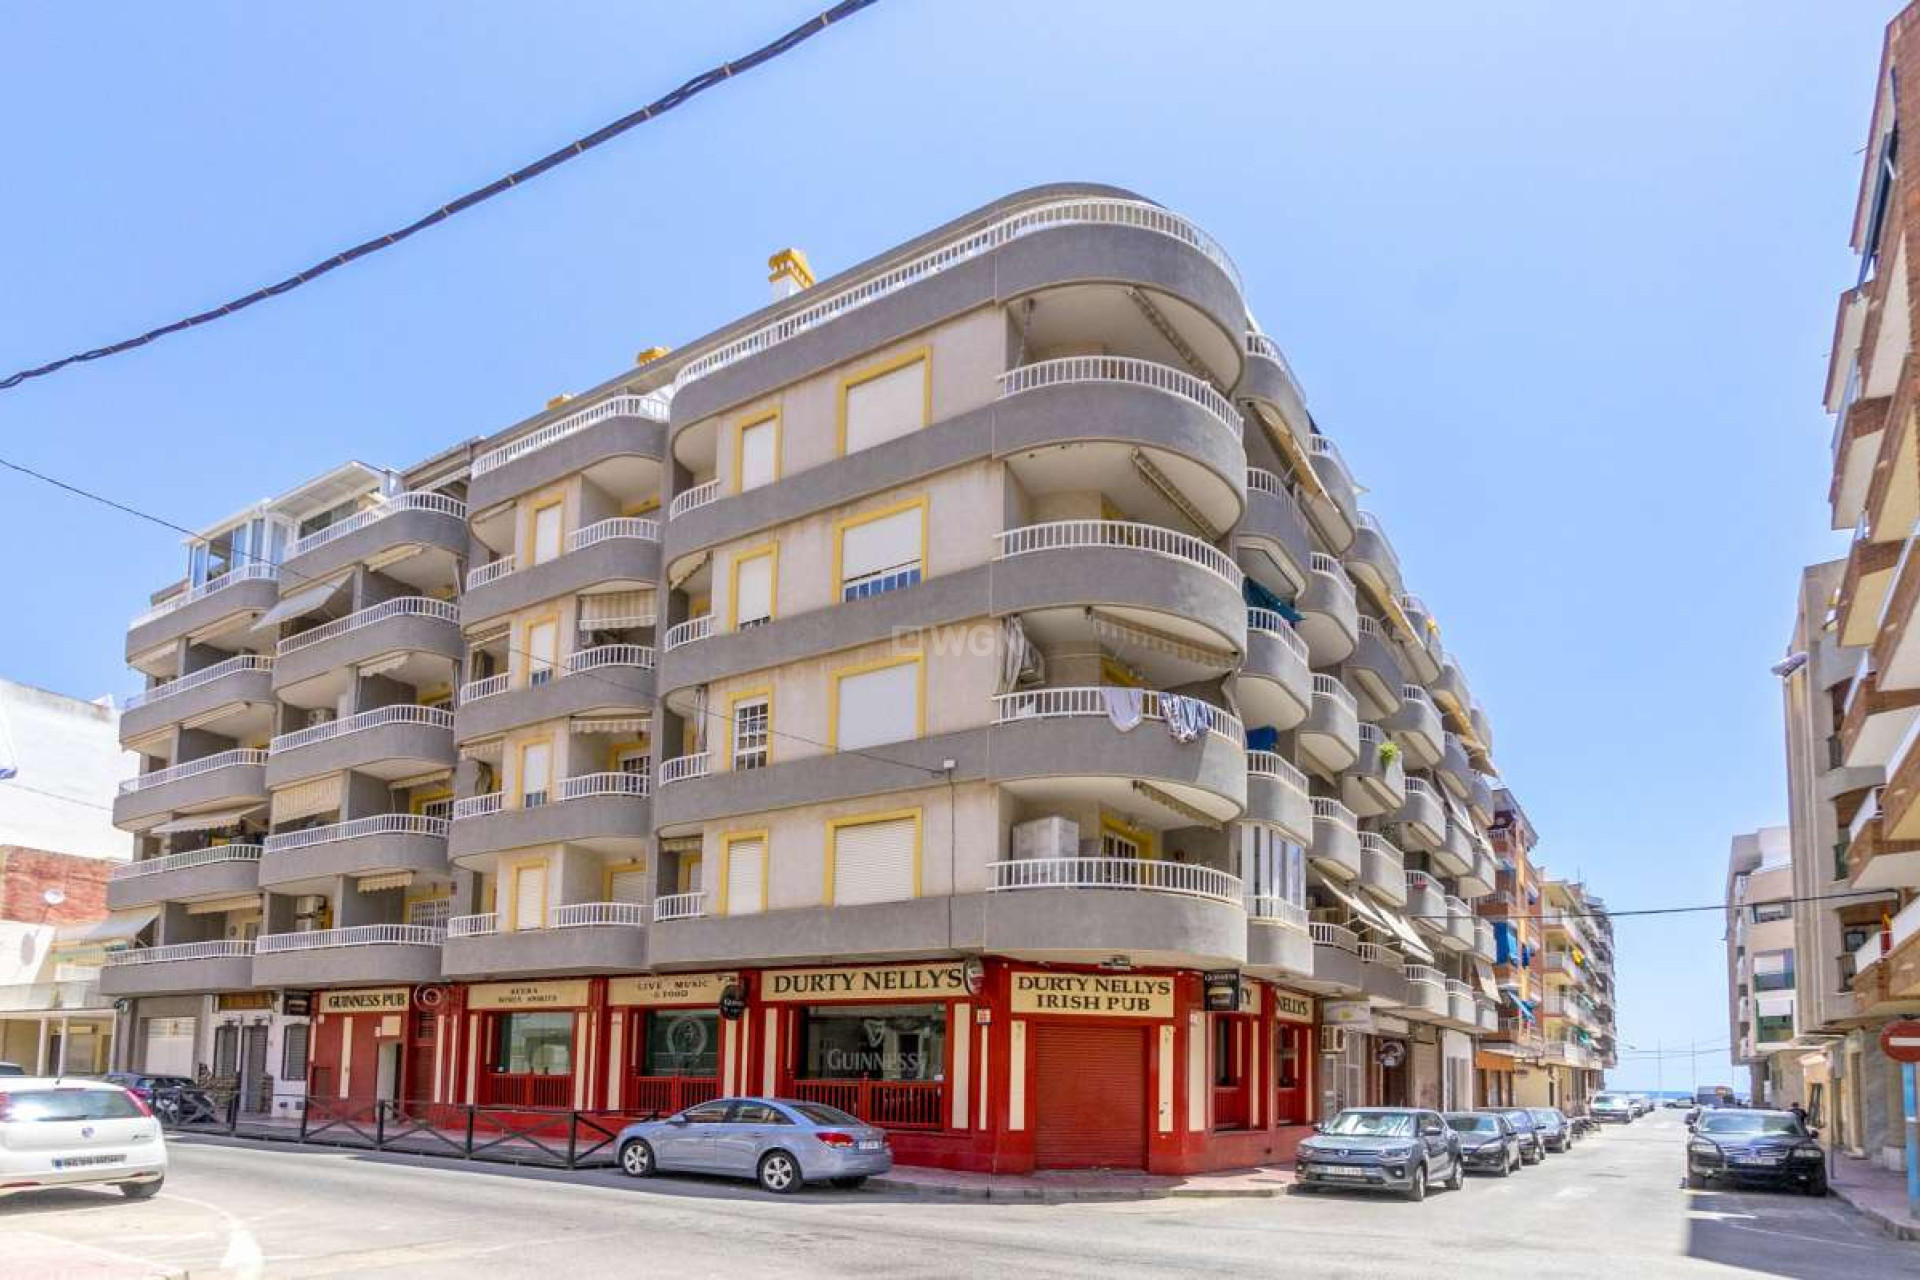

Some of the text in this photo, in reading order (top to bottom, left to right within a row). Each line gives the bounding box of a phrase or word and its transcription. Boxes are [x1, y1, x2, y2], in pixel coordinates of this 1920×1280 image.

[774, 968, 962, 993] DURTY NELLY'S
[1018, 976, 1170, 995] DURTY NELLYS
[328, 992, 405, 1009] GUINNESS PUB
[1036, 994, 1150, 1012] IRISH PUB
[827, 1048, 919, 1072] GUINNESS
